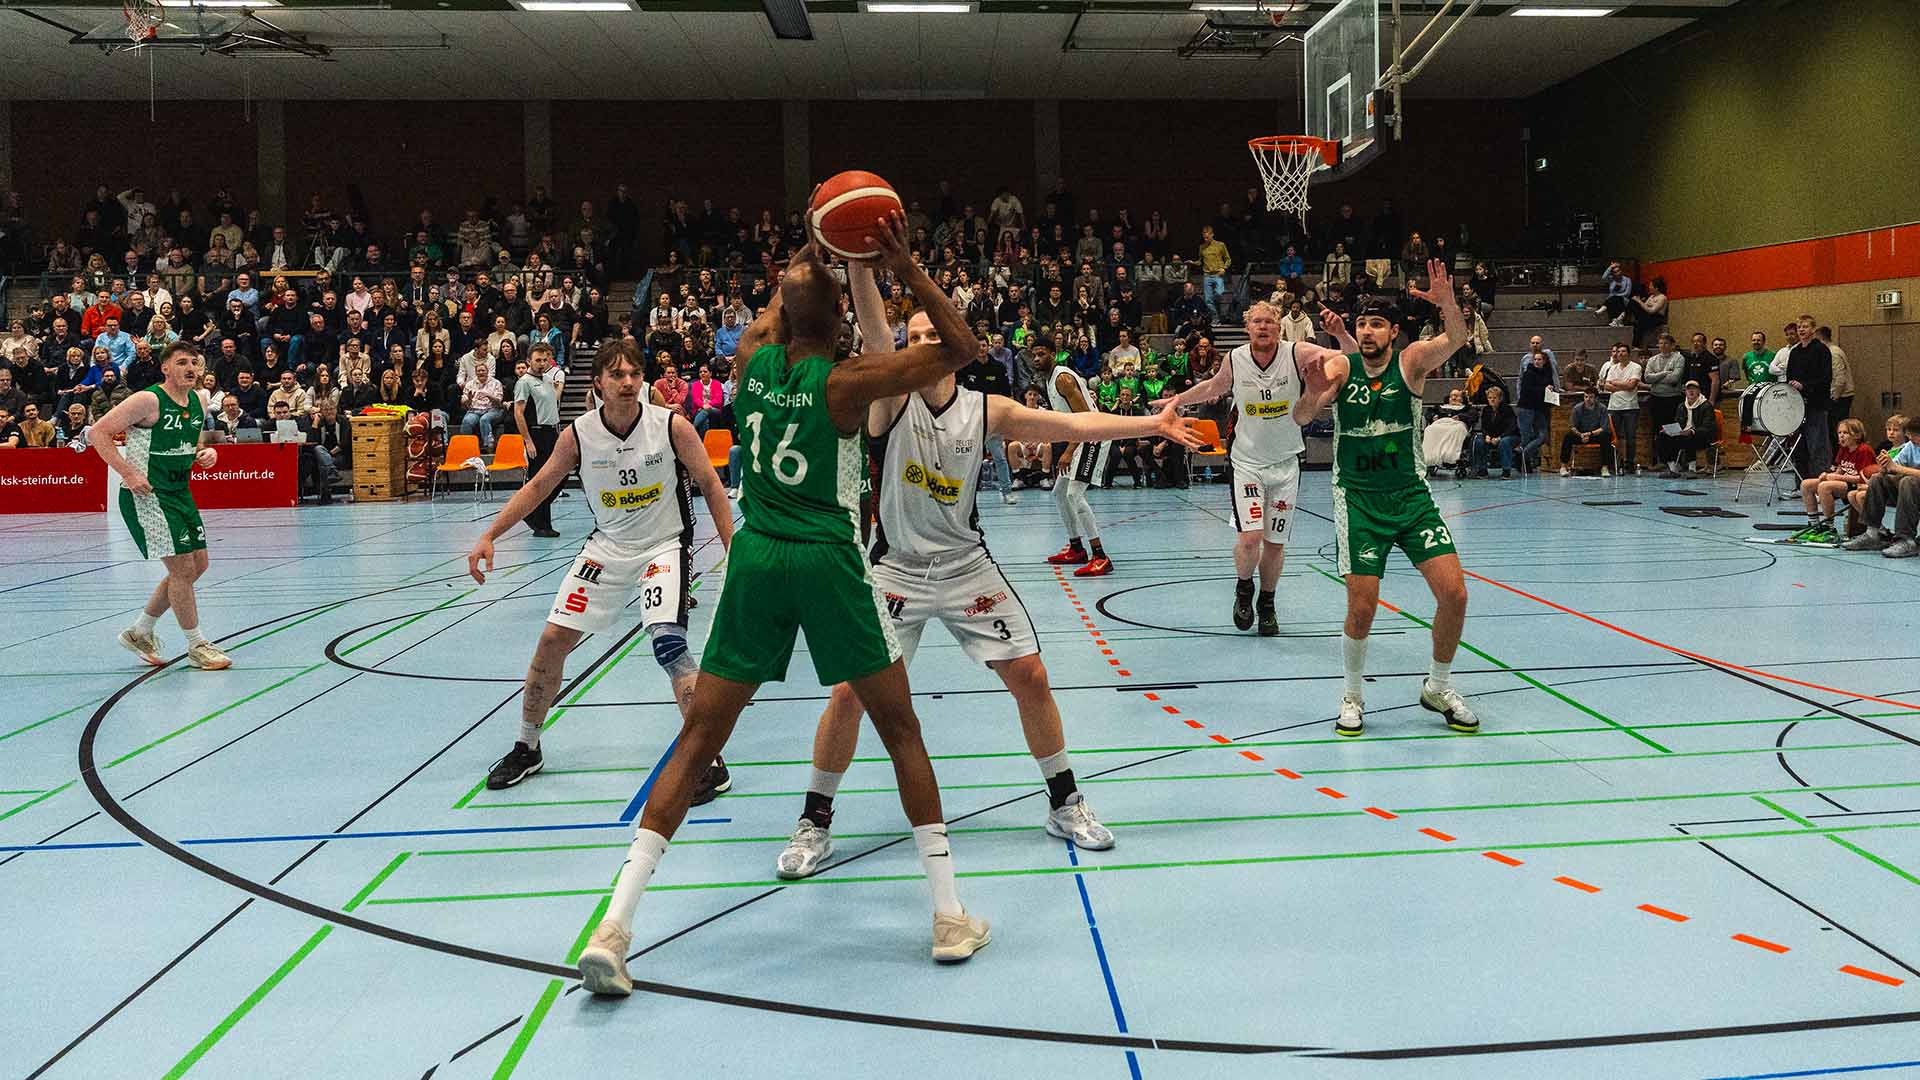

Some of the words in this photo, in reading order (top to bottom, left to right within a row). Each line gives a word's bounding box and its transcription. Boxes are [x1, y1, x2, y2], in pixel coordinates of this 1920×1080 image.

[747, 378, 764, 395] BG
[763, 391, 813, 408] AACHEN
[1259, 388, 1272, 401] 18
[1346, 383, 1370, 405] 23
[163, 414, 183, 430] 24
[745, 411, 808, 486] 16
[645, 458, 663, 466] DENT
[0, 474, 84, 487] ksk-steinfurt.de
[190, 468, 275, 481] ksk-steinfurt.de
[618, 468, 638, 486] 33
[1271, 517, 1286, 533] 18
[1419, 526, 1451, 549] 23
[644, 586, 662, 610] 33
[993, 619, 1012, 641] 3
